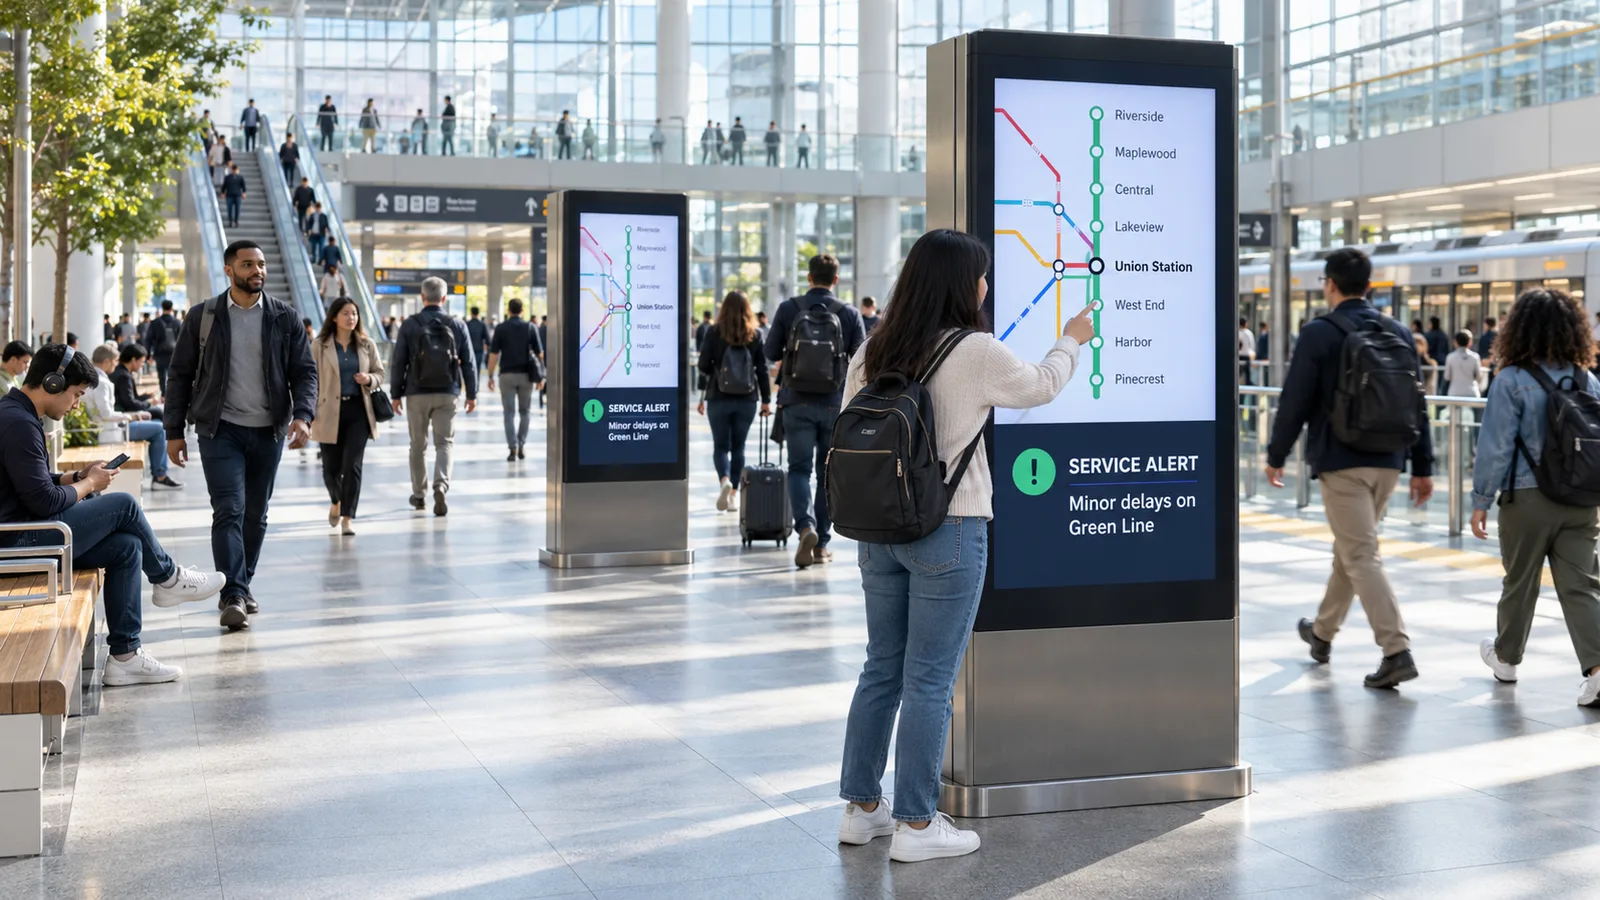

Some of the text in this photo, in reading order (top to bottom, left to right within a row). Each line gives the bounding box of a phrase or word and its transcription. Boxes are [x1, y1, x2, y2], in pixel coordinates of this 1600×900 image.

[1115, 109, 1165, 123] Riverside
[1115, 146, 1177, 161] Maplewood
[1114, 183, 1154, 196] Central
[1115, 220, 1165, 233] Lakeview
[636, 244, 667, 253] Maplewood
[636, 263, 656, 271] Central
[1114, 260, 1193, 273] Union Station
[636, 303, 674, 311] Union Station
[1114, 299, 1165, 311] West End
[1115, 336, 1153, 348] Harbor
[1115, 373, 1165, 385] Pinecrest
[608, 403, 670, 413] SERVICE ALERT
[608, 421, 631, 430] Minor
[632, 421, 658, 431] delays
[608, 432, 649, 441] Green Line
[1068, 455, 1199, 475] SERVICE ALERT
[1069, 492, 1197, 513] Minor delays on
[1068, 517, 1155, 536] Green Line
